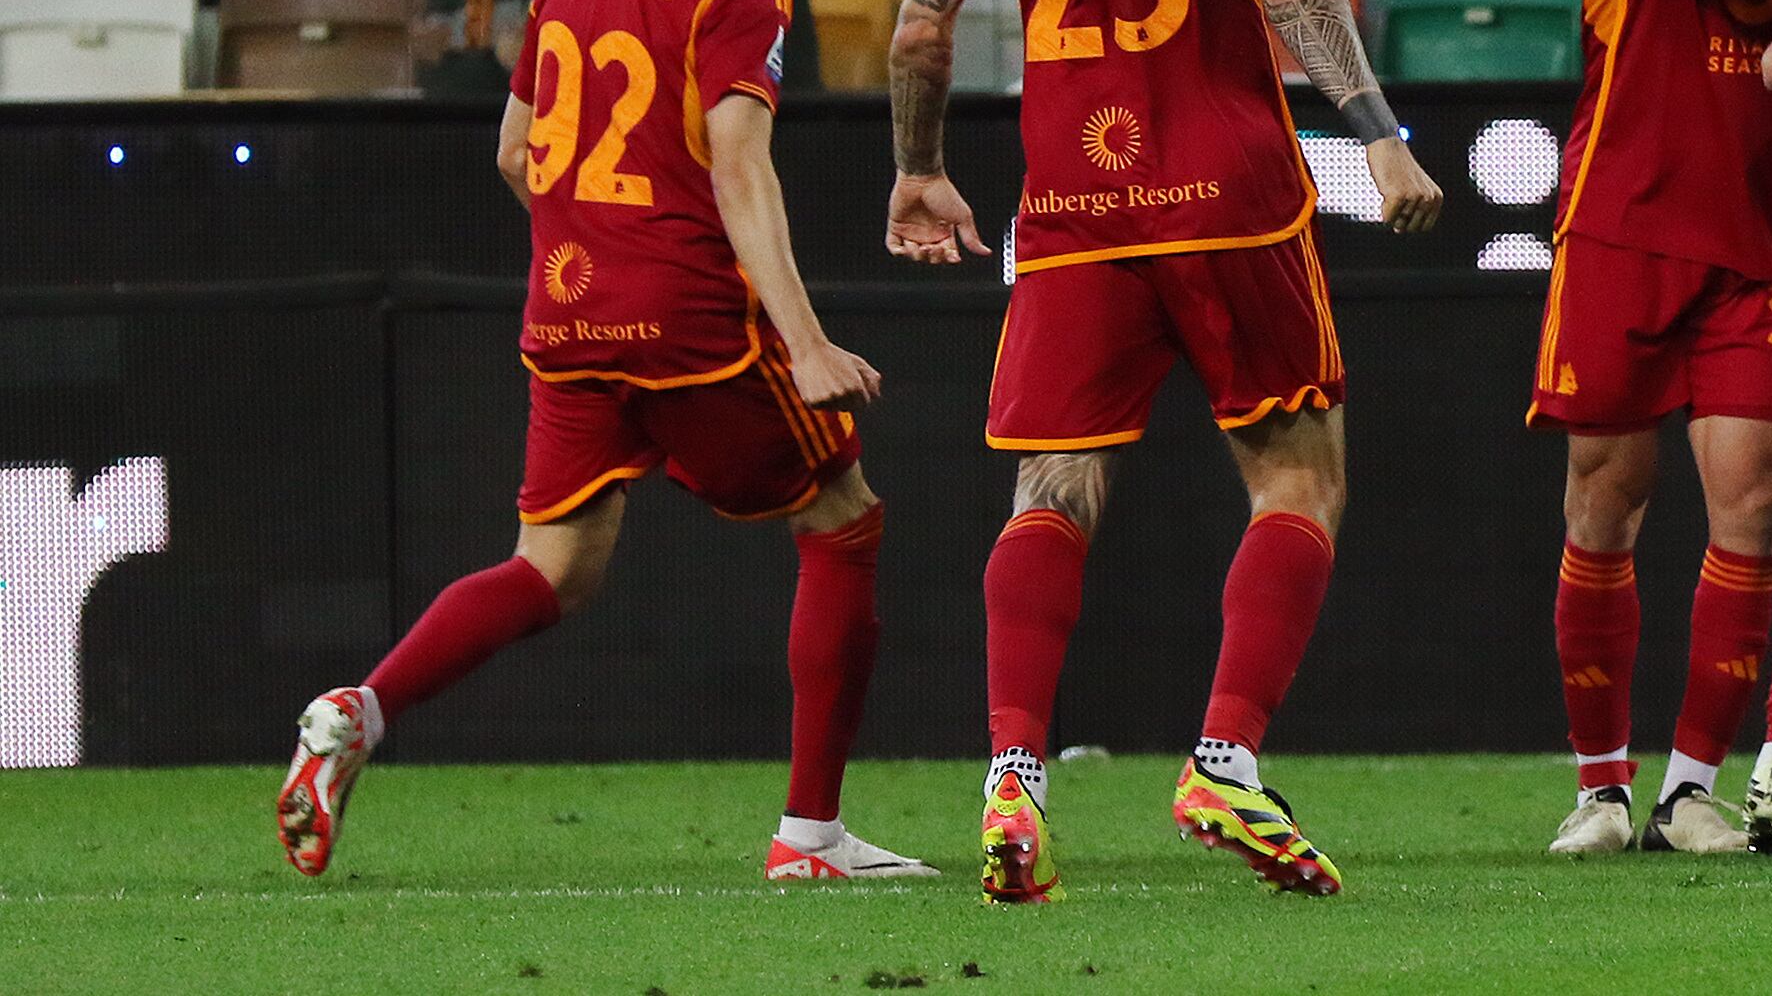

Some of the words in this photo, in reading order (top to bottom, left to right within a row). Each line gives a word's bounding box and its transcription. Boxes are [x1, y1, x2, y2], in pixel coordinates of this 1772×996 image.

[526, 19, 657, 207] 92
[1020, 189, 1120, 216] Auberge
[1128, 179, 1221, 208] Resorts
[574, 319, 662, 341] Resorts
